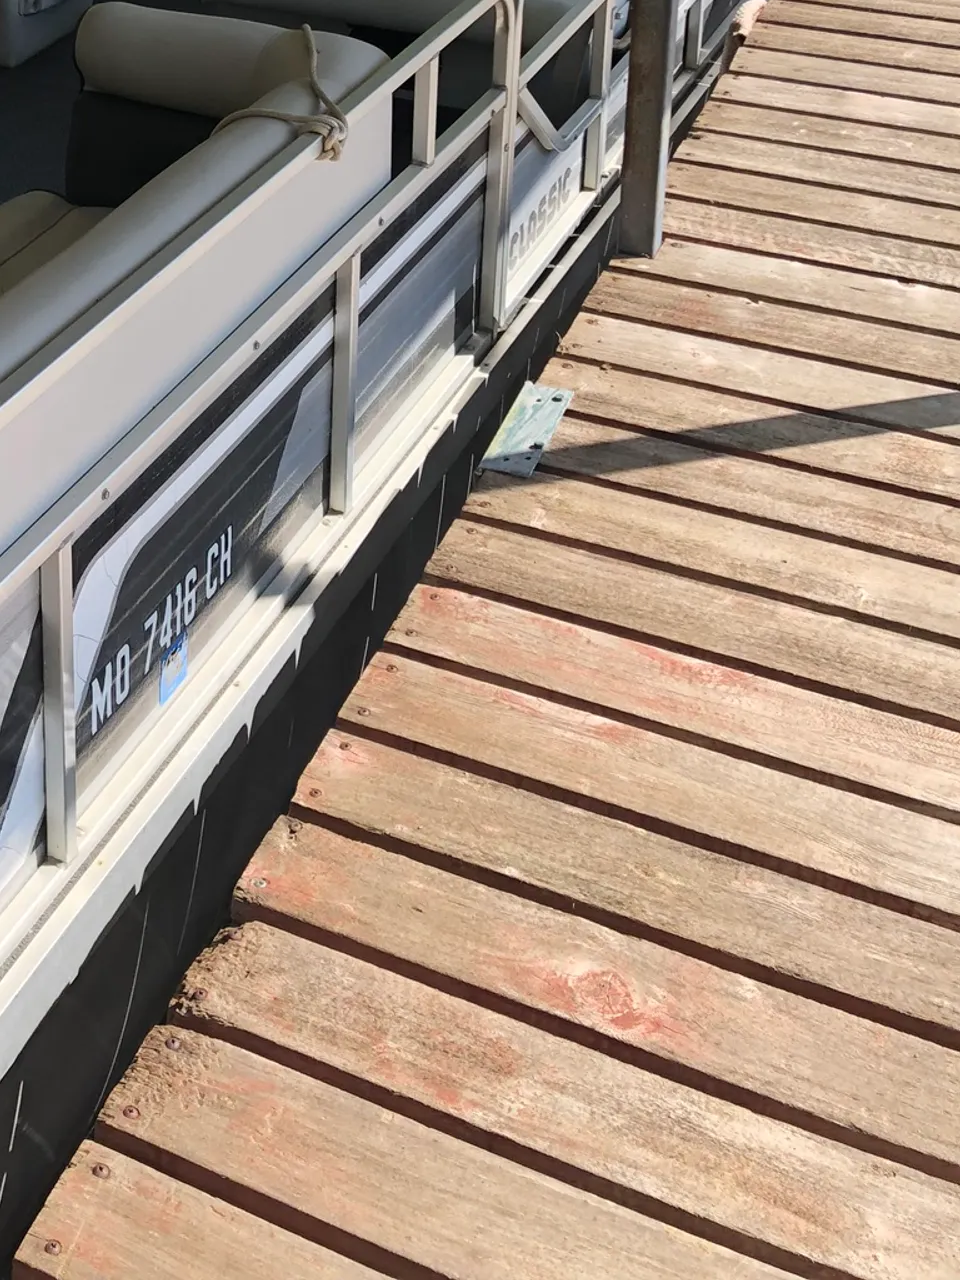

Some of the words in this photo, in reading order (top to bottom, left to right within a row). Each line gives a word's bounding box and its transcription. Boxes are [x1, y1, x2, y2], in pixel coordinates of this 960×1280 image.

[508, 167, 572, 269] CLASSIC
[91, 643, 131, 737] MO
[143, 567, 198, 676] 7416
[205, 524, 234, 601] CH
